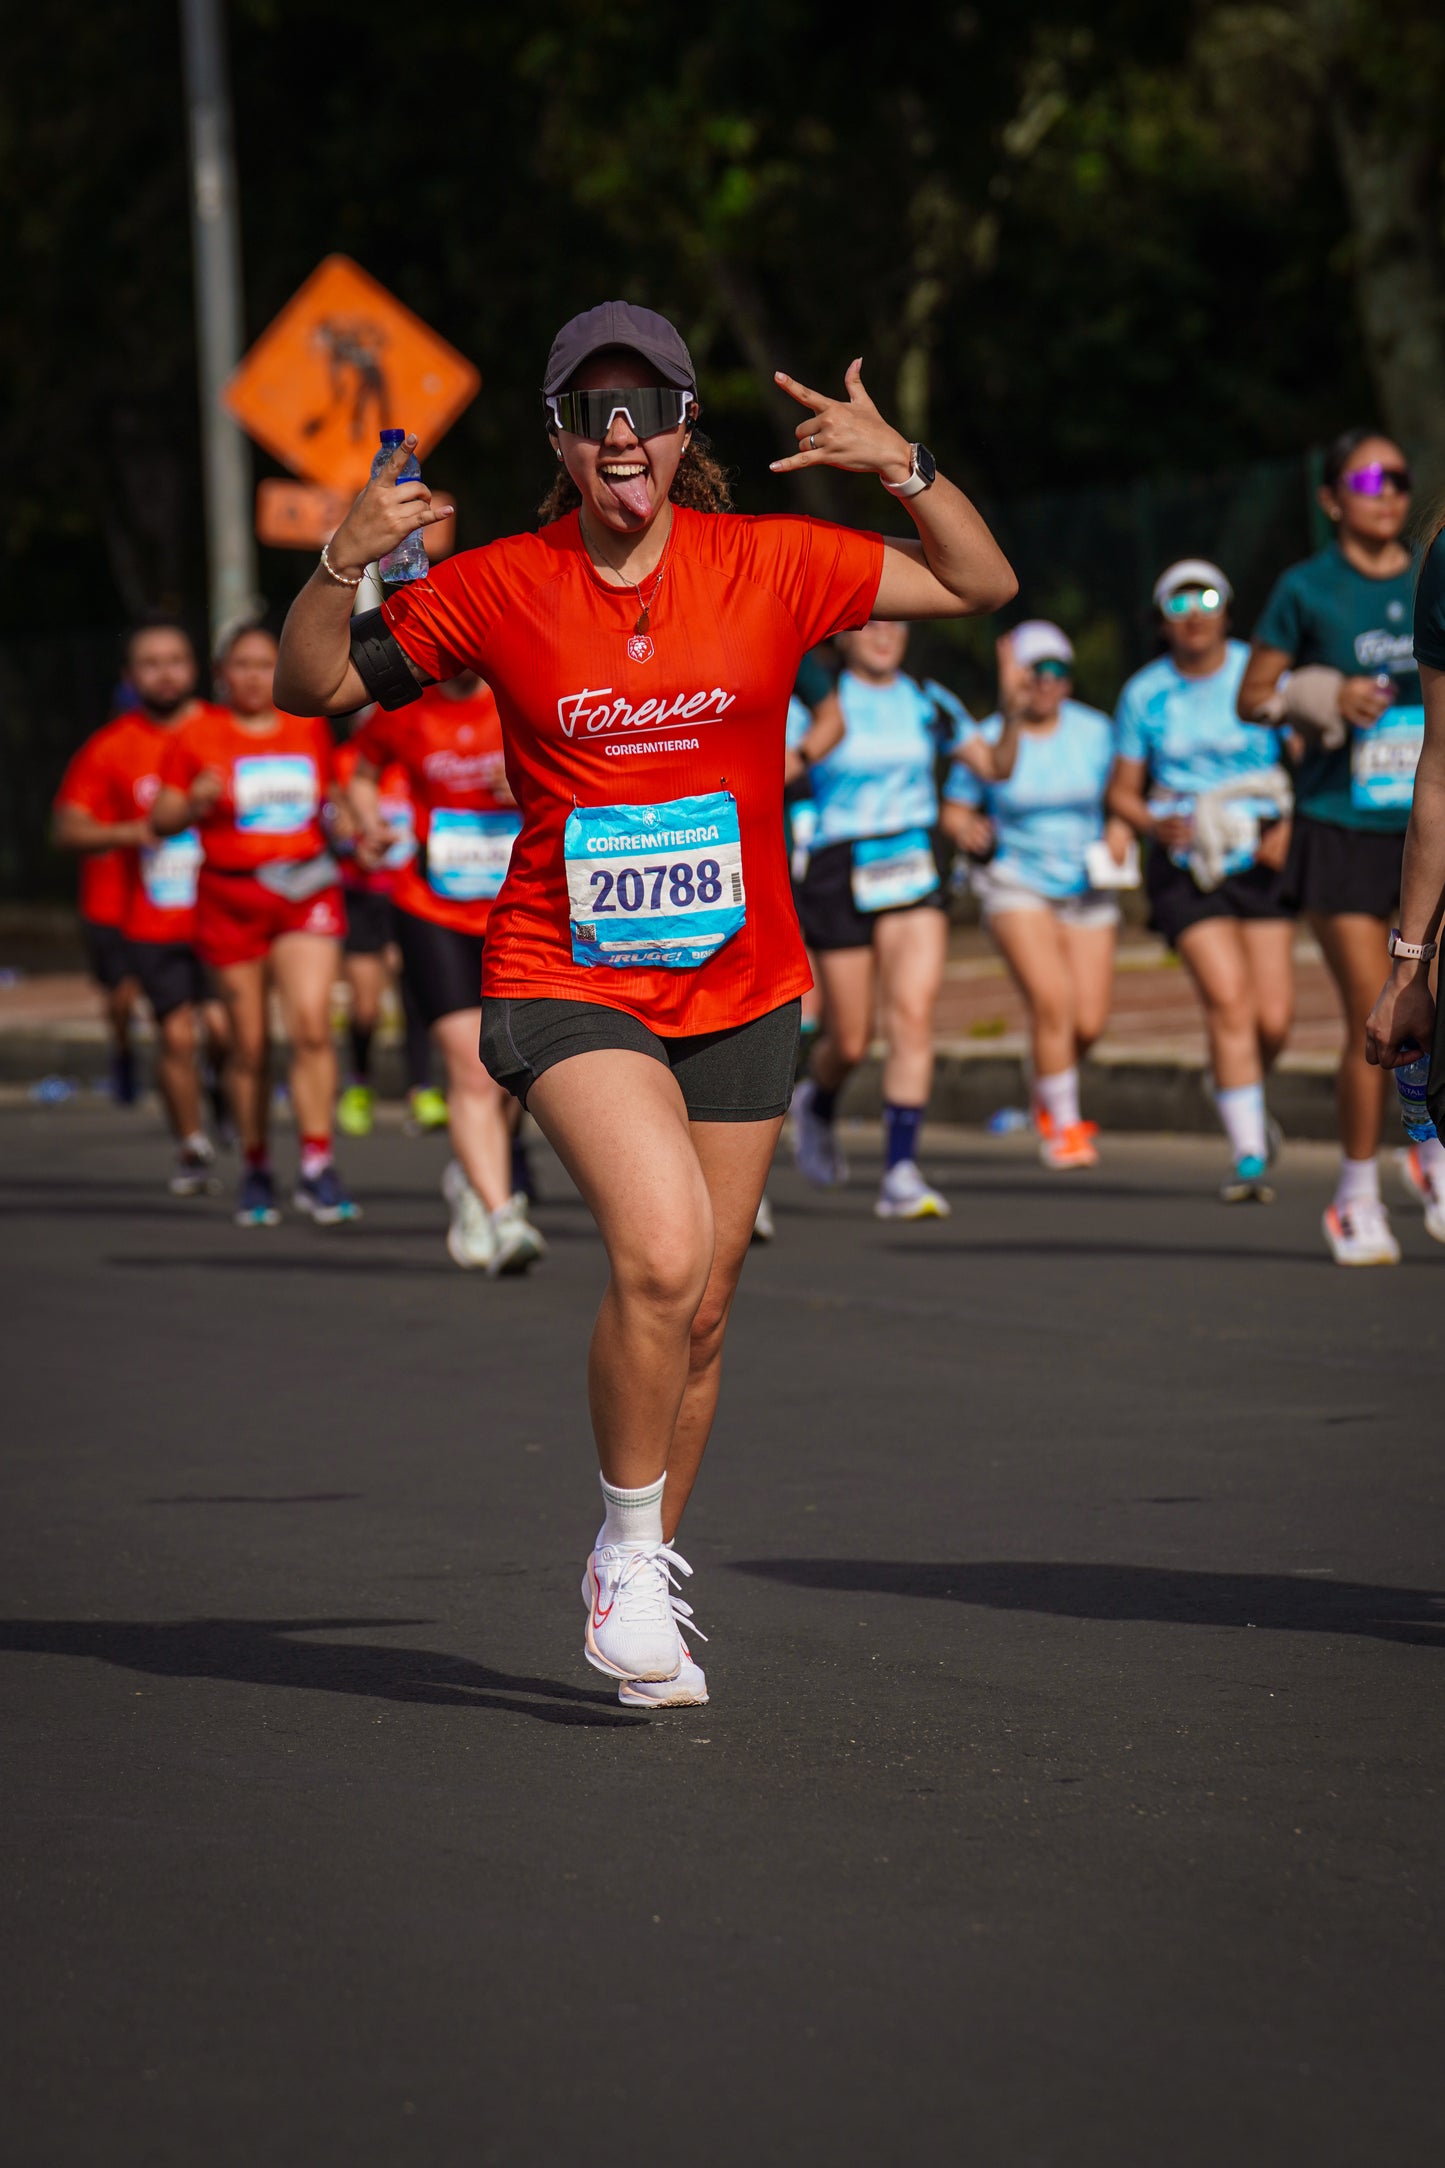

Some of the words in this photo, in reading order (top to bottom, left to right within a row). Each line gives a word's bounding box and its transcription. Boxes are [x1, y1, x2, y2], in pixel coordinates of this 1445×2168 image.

[558, 687, 736, 737] Forever
[605, 738, 700, 756] CORREMITIERRA
[586, 825, 720, 852] CORREMITIERRA
[590, 859, 722, 913] 20788
